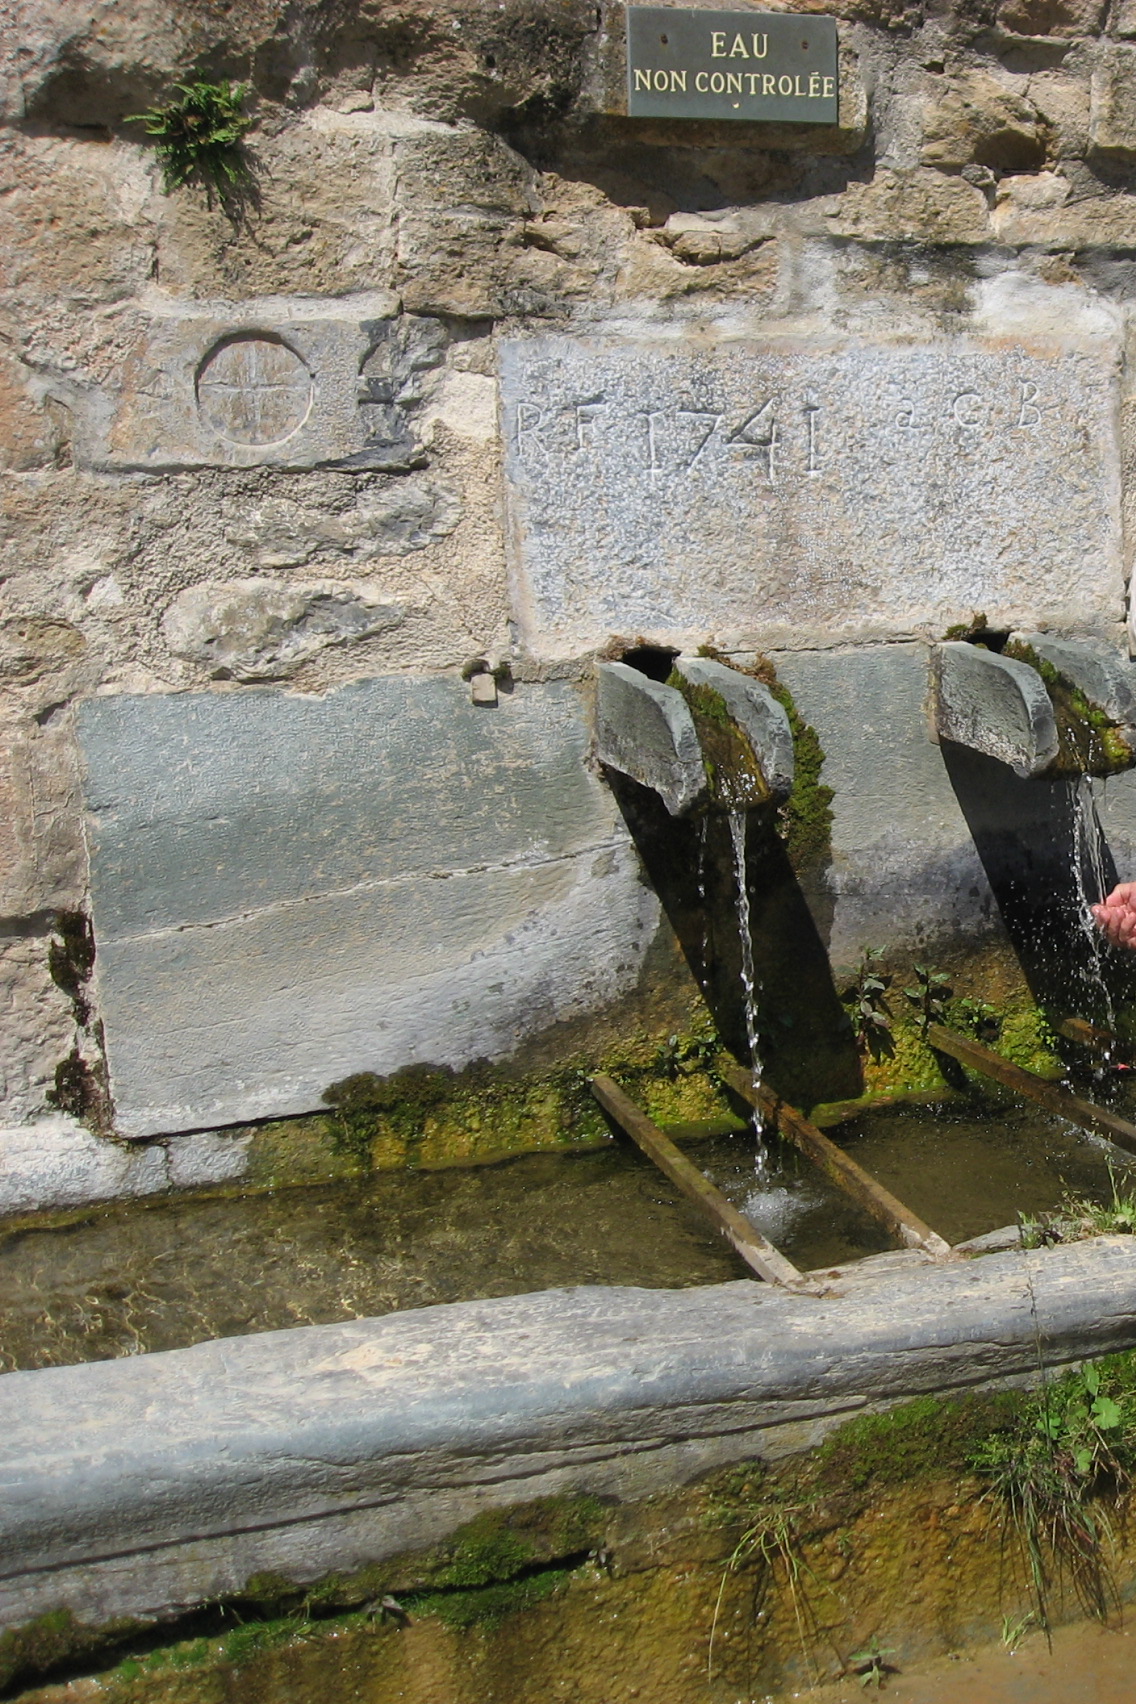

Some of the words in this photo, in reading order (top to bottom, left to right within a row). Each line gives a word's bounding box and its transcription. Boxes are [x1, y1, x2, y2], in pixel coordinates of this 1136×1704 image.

[711, 31, 769, 59] EAU
[633, 68, 688, 92] NON
[694, 71, 835, 98] CONTROLÉE
[637, 396, 824, 482] 1741
